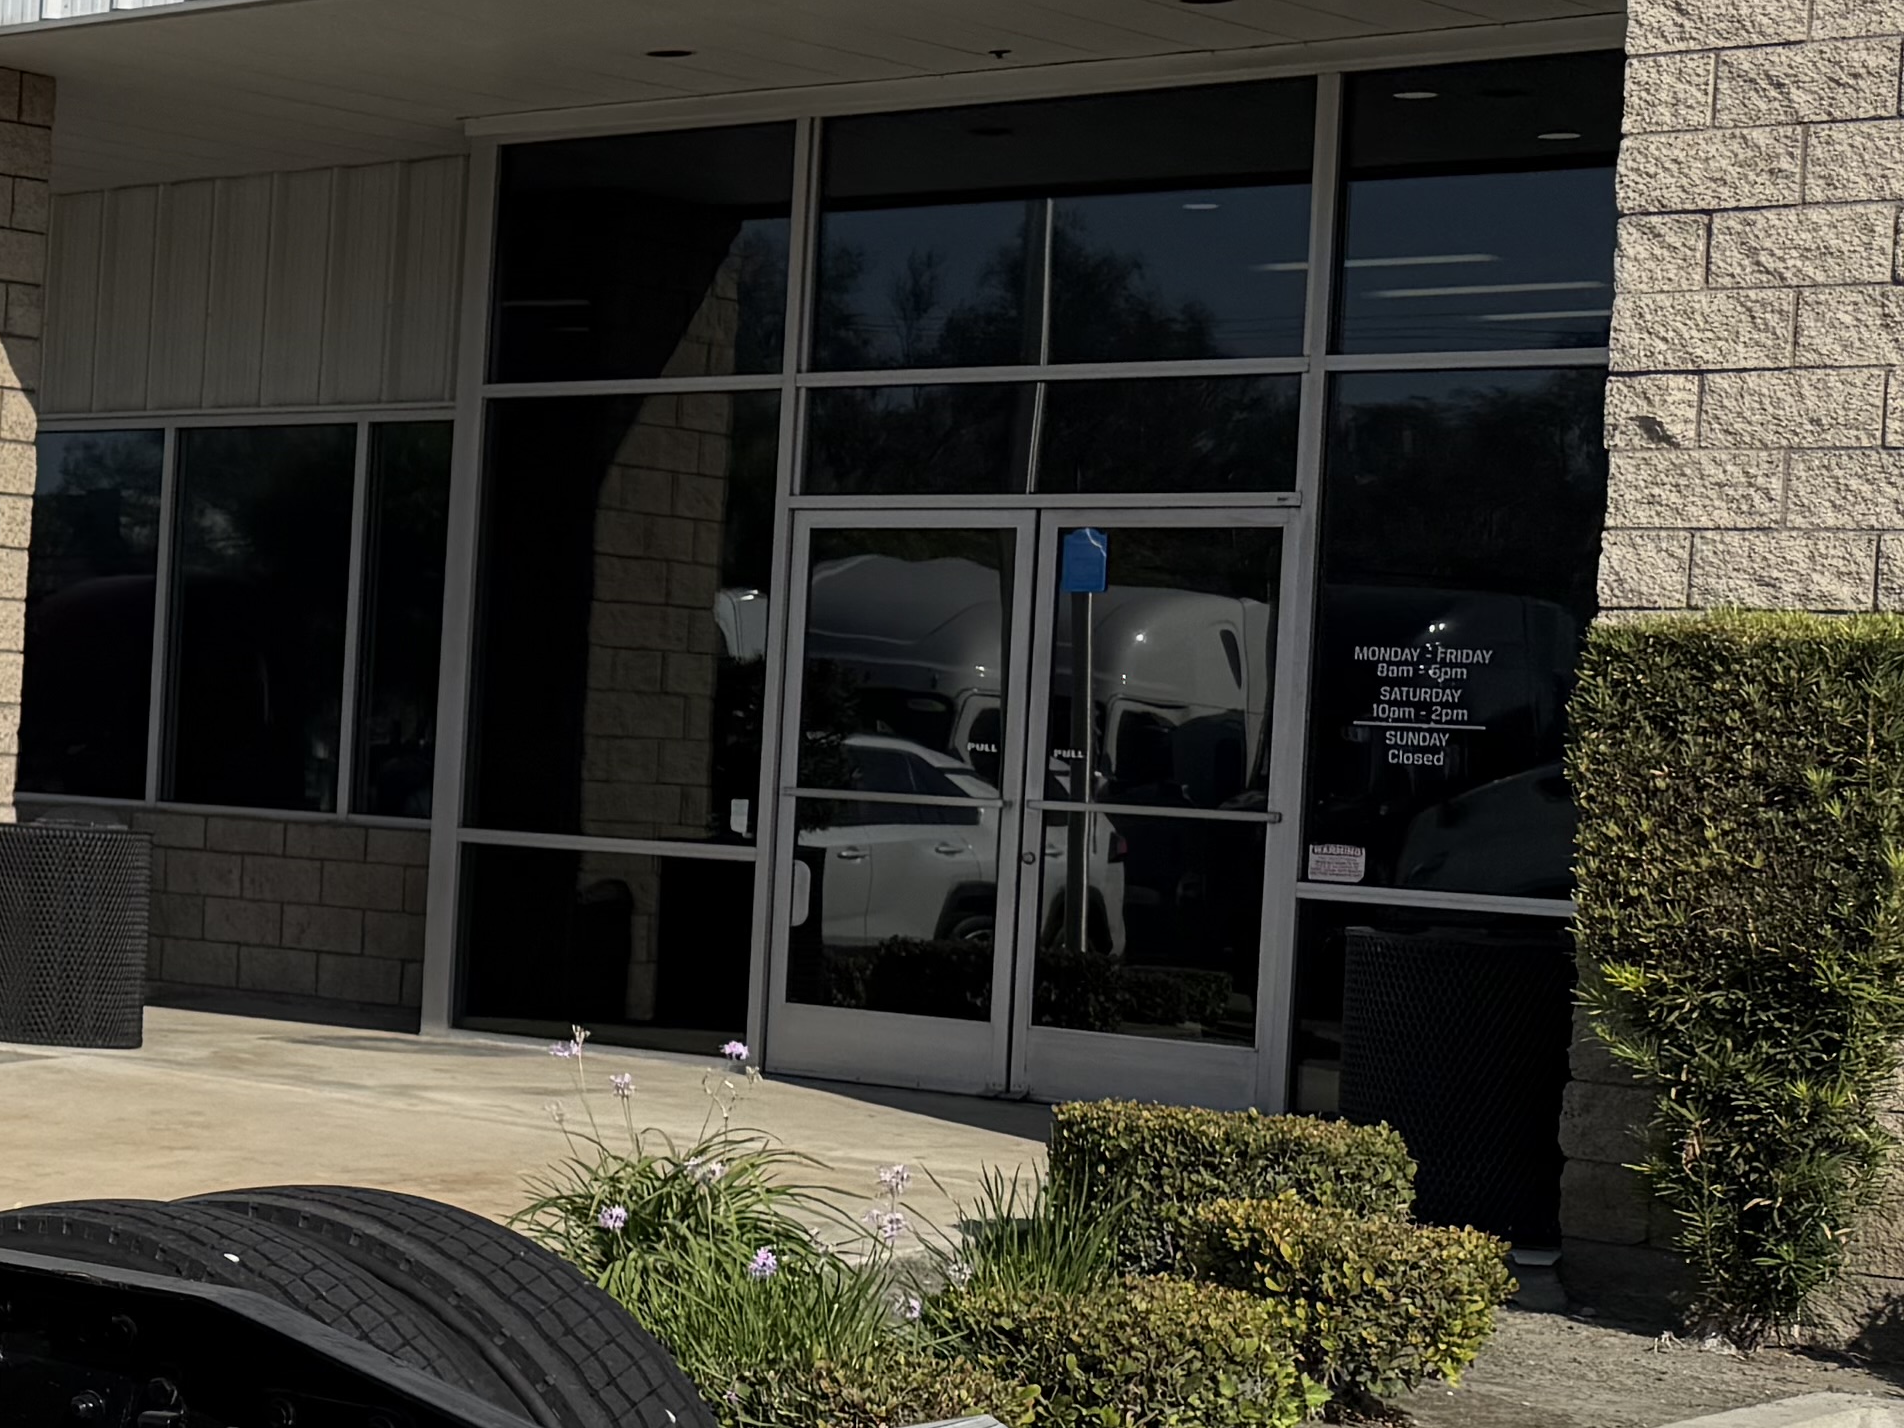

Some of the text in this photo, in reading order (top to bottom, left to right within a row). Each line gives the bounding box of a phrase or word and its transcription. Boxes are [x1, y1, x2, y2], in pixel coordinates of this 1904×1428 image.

[1354, 645, 1420, 662] MONDAY
[1437, 647, 1493, 664] FRIDAY
[1377, 663, 1414, 677] 8am
[1380, 686, 1462, 703] SATURDAY
[1431, 706, 1468, 723] 2pm
[1386, 731, 1449, 746] SUNDAY
[967, 742, 998, 753] PULL
[1054, 748, 1085, 759] PULL
[1388, 750, 1444, 766] Closed
